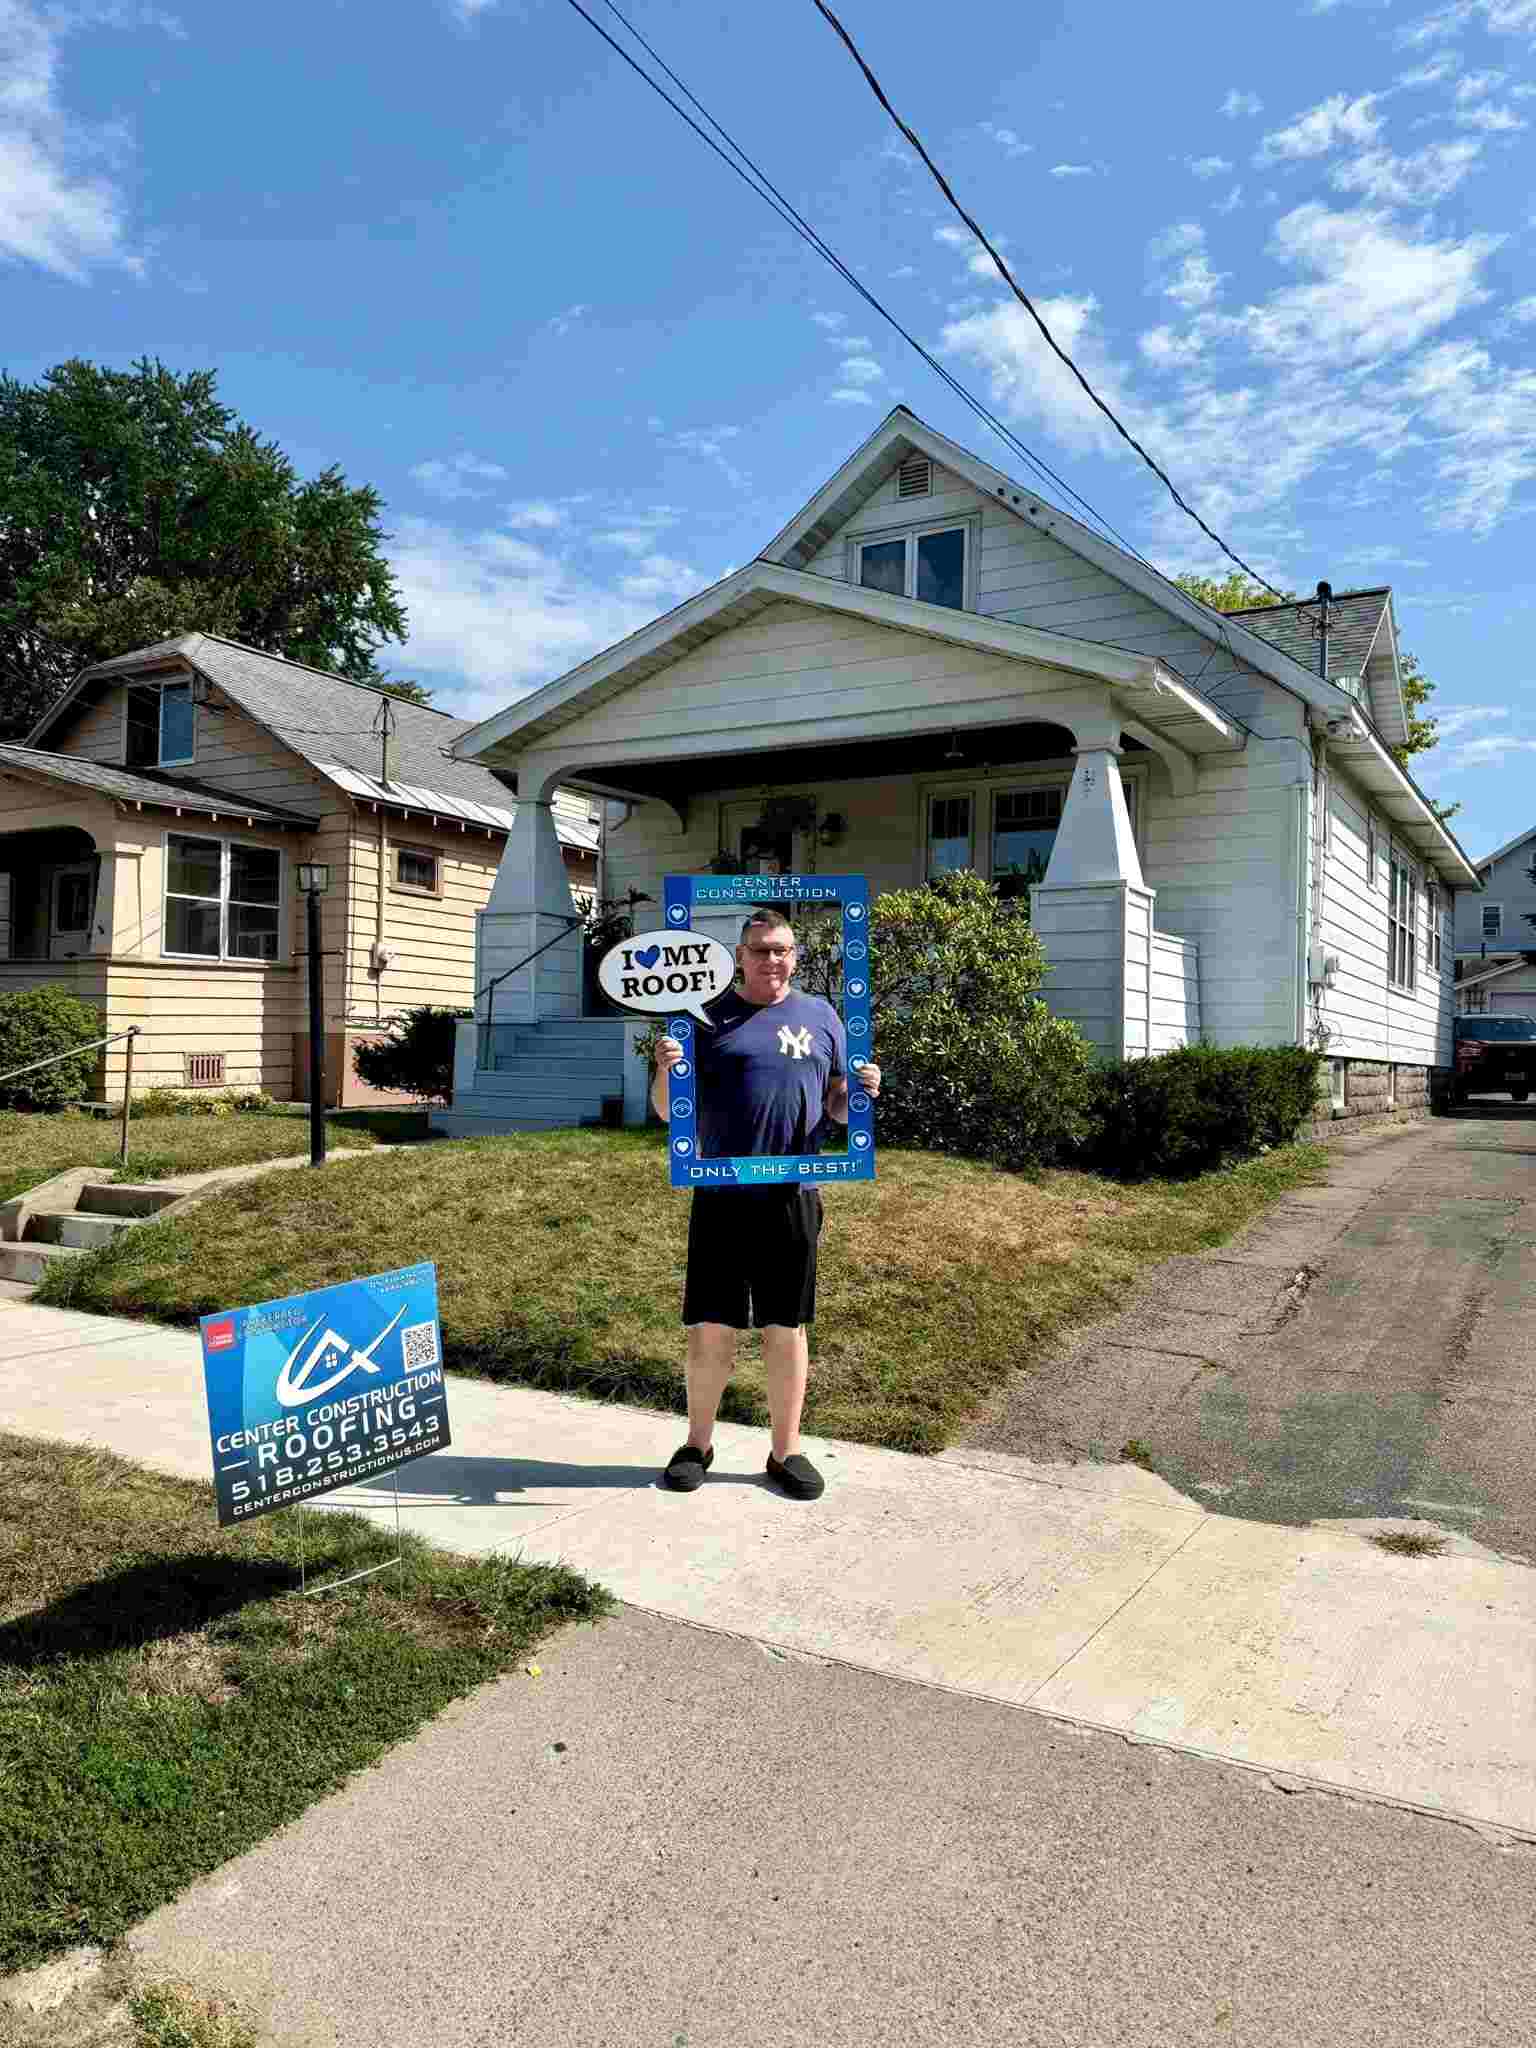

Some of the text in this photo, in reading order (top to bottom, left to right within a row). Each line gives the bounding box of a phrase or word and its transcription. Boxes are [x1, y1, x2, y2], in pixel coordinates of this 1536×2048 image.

[696, 887, 837, 898] CONSTRUCTION
[732, 876, 801, 887] CENTER
[621, 943, 711, 971] I MY
[621, 970, 716, 998] ROOF!
[776, 1025, 813, 1059] NY
[752, 1164, 789, 1177] THE
[216, 1368, 442, 1454] CENTER CONSTRUCTION
[257, 1395, 417, 1468] ROOFING
[231, 1415, 440, 1501] 518.253.3543
[232, 1435, 441, 1516] CENTERCONSTRUCTIONUS.COM
